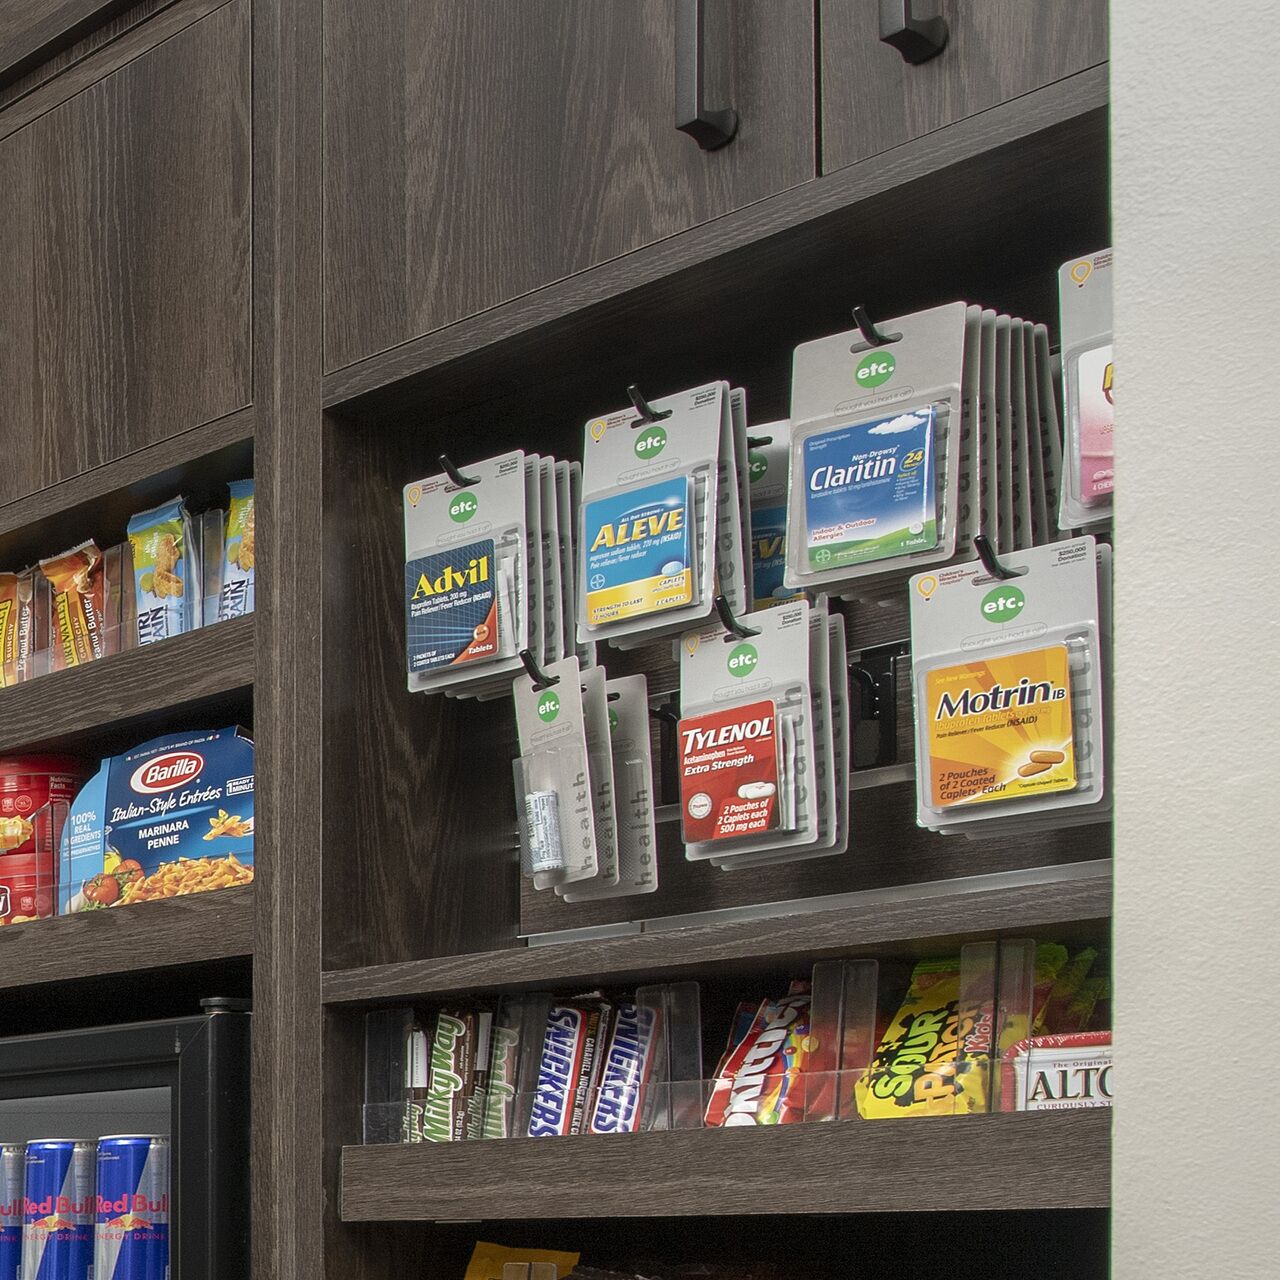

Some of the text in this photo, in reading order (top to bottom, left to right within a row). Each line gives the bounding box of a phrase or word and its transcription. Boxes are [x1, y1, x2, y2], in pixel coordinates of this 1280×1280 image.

[857, 361, 894, 378] etc.
[904, 450, 923, 464] 24
[811, 457, 896, 491] Claritin
[591, 508, 684, 552] ALEVE
[411, 556, 488, 600] Advil
[469, 644, 493, 654] Tablets
[936, 679, 1052, 720] Motrin
[683, 717, 772, 755] TYLENOL
[146, 760, 196, 784] Barilla
[684, 754, 754, 776] Extra Strength
[947, 768, 988, 780] Pouches
[961, 775, 995, 787] Coated
[982, 783, 1007, 793] Each
[110, 786, 222, 823] Italian-Style Entrées
[730, 801, 759, 813] Pouches
[71, 811, 96, 825] 100%
[724, 812, 750, 823] Caplets
[74, 823, 91, 834] REAL
[139, 821, 189, 839] MARINARA
[720, 824, 735, 833] 500
[148, 835, 179, 850] PENNE
[877, 1011, 948, 1099] SOUR
[528, 1008, 582, 1136] SNICKERS
[97, 1194, 127, 1213] Red
